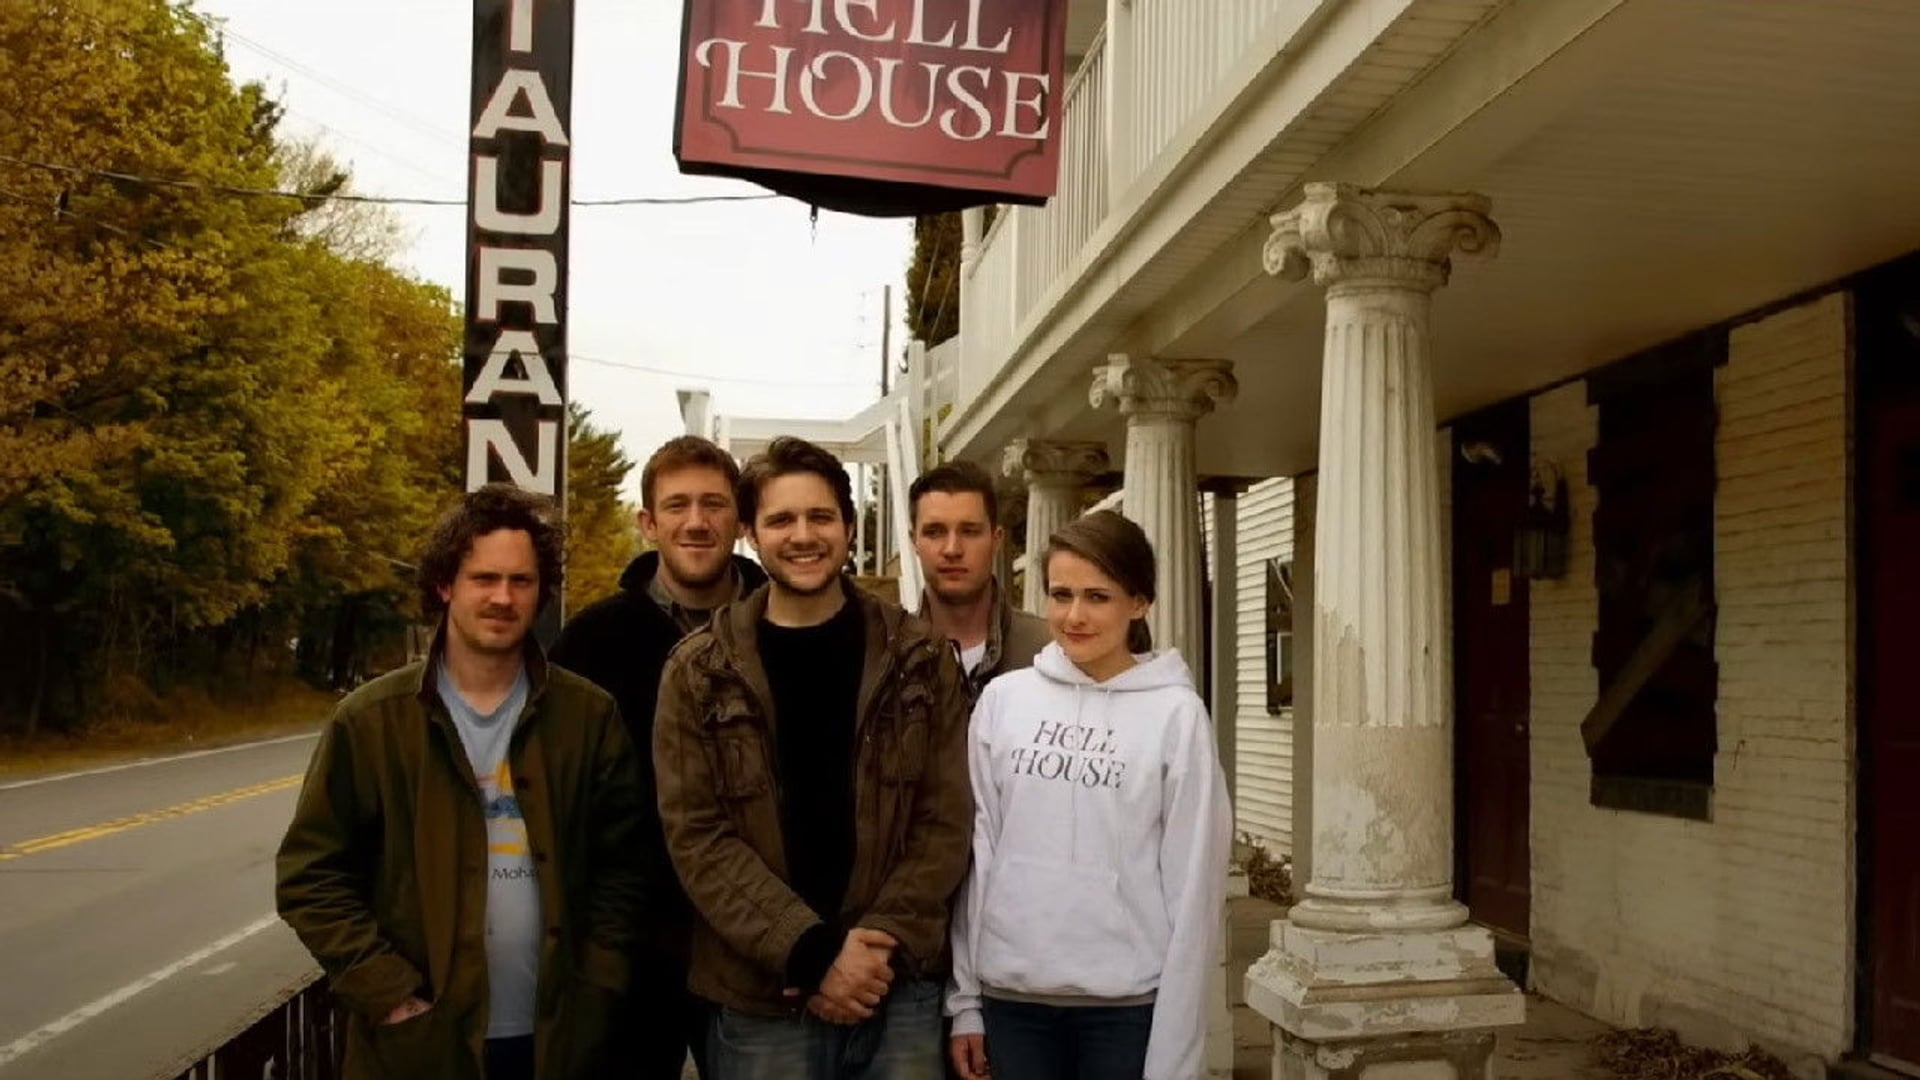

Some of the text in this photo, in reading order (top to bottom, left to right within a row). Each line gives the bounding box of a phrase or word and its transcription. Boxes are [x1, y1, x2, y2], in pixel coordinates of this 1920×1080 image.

[695, 38, 1050, 141] HOUSE
[1033, 720, 1115, 754] HELL
[1010, 748, 1125, 789] HOUSE
